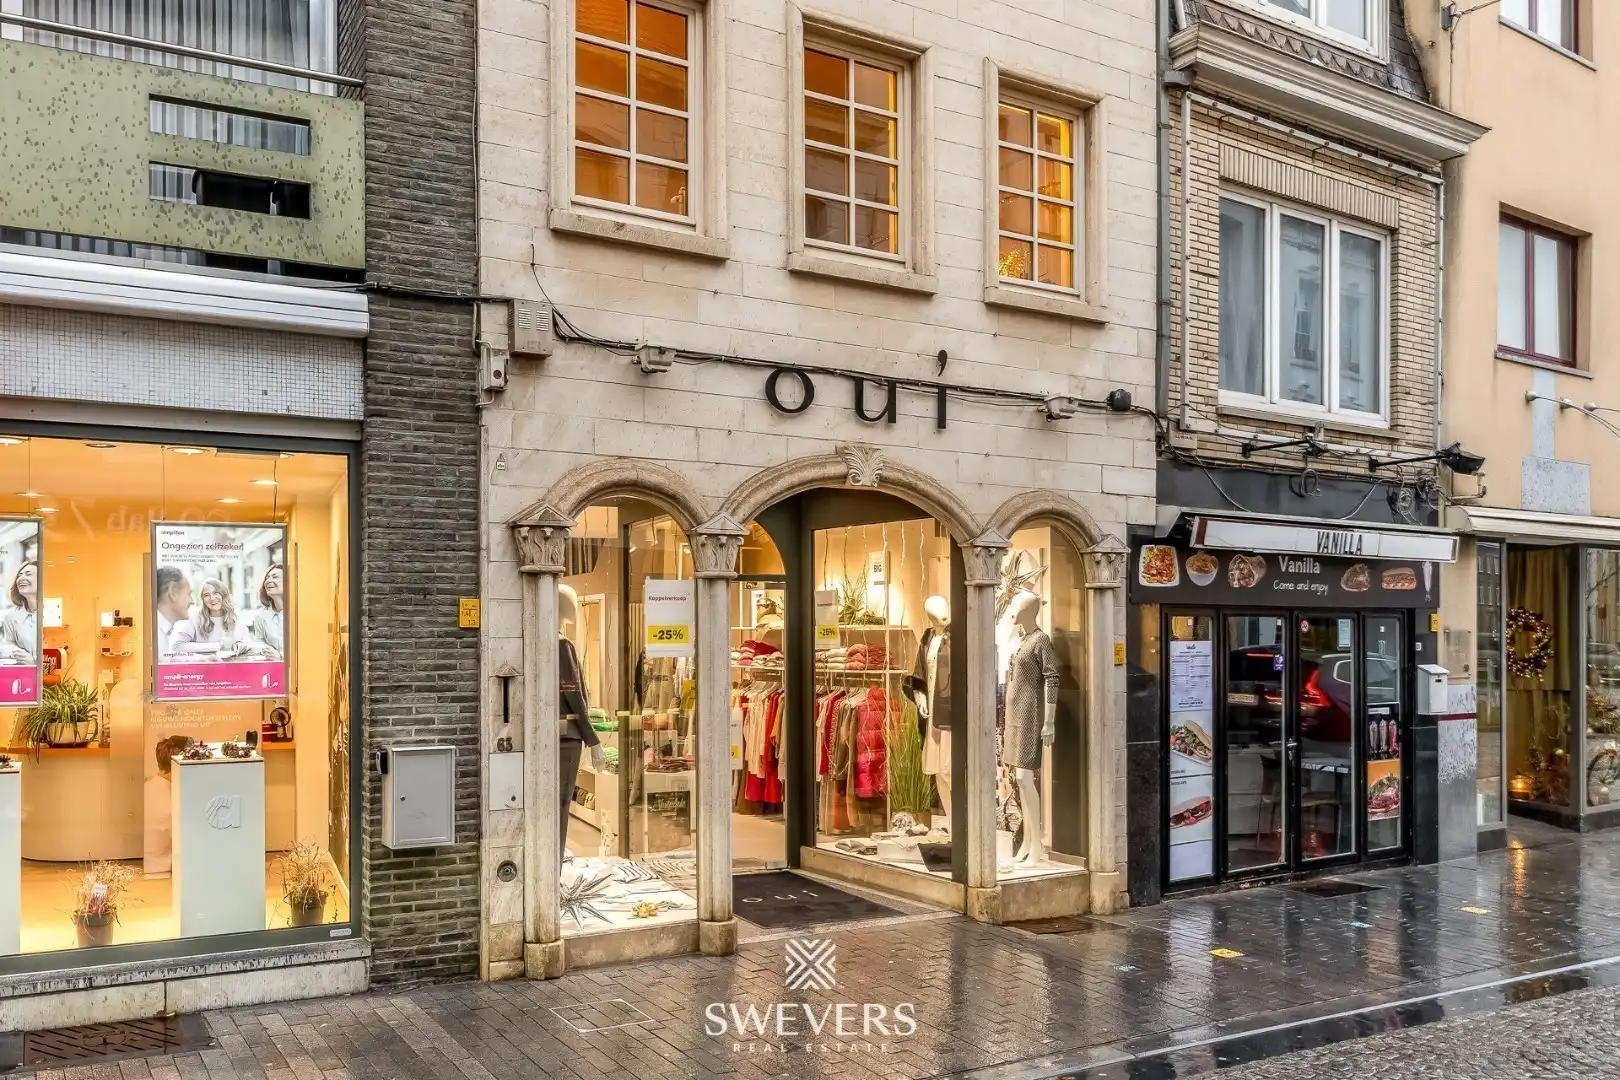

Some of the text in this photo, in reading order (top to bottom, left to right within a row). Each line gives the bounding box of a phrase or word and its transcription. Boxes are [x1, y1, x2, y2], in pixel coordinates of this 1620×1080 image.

[161, 541, 204, 552] Ongezien
[1316, 530, 1363, 556] VANILLA
[1278, 555, 1321, 574] Vanilla
[1273, 579, 1329, 596] Come and enjoy
[652, 629, 684, 640] -25%
